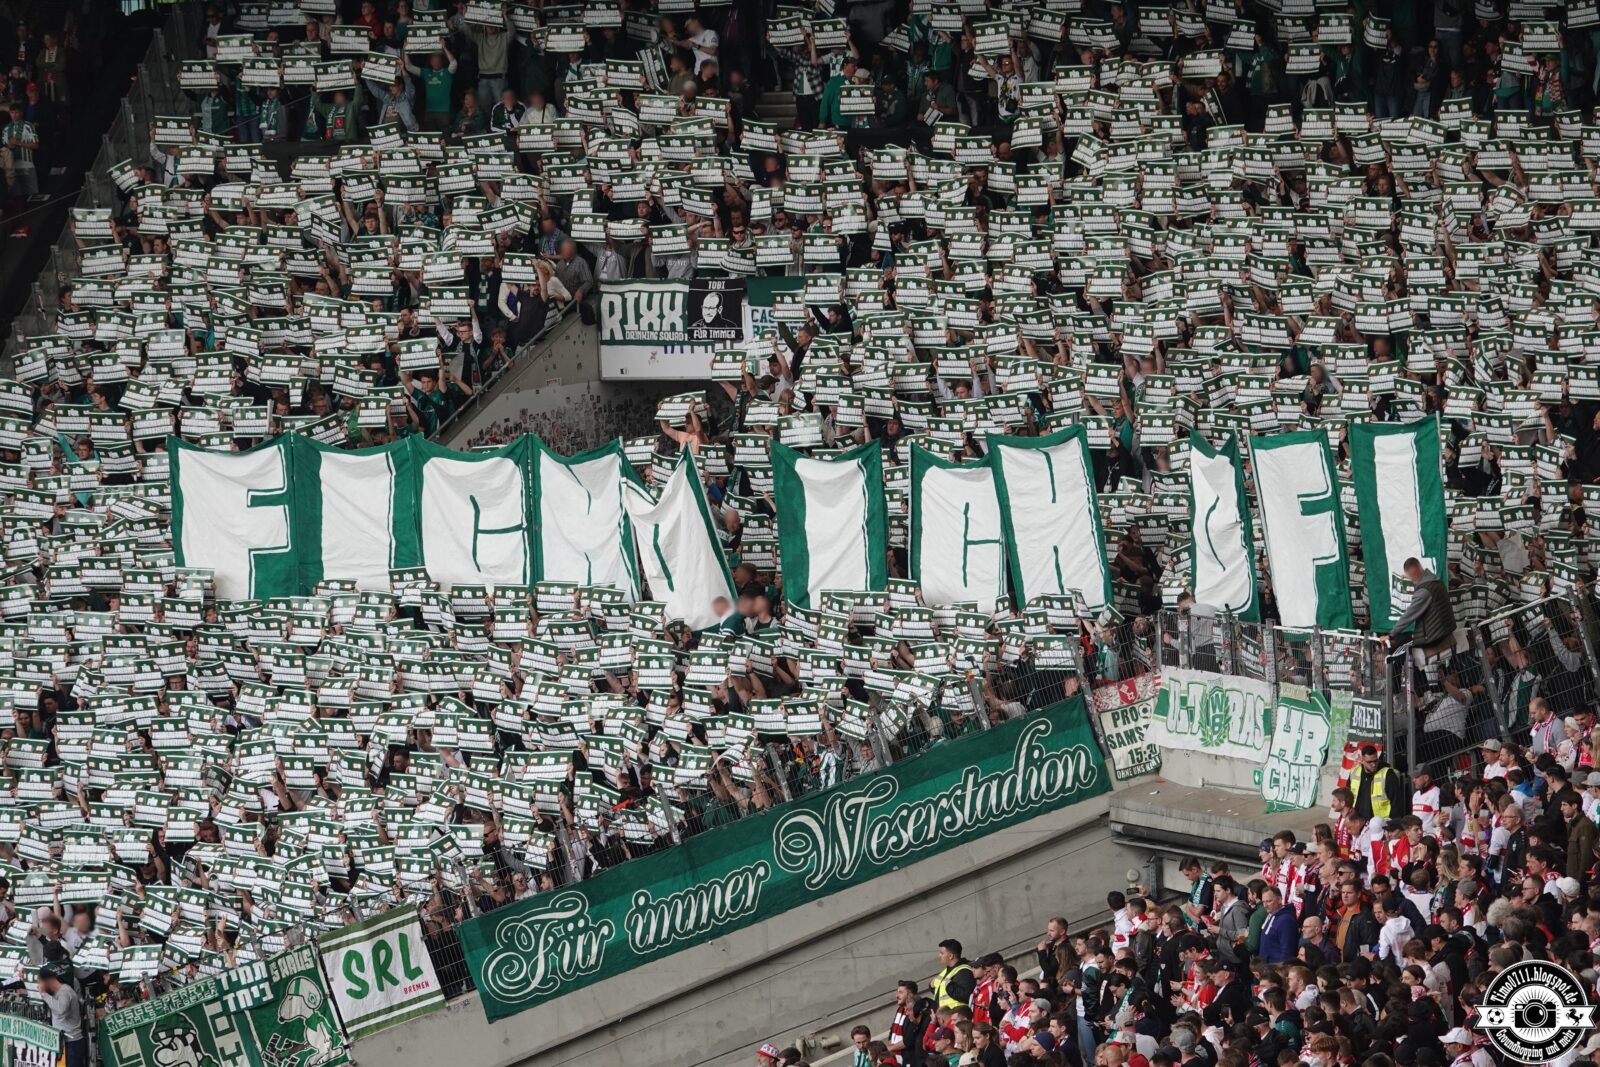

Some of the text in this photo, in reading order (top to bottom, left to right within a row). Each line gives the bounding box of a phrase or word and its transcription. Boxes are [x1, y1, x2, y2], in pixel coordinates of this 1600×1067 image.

[708, 281, 726, 290] TOBI
[601, 292, 683, 340] RIXX
[625, 330, 684, 341] DRINKING SQUAD
[709, 329, 736, 339] IMMER
[1111, 706, 1139, 728] PRO
[1271, 703, 1330, 765] HB
[1262, 760, 1319, 809] CREW
[482, 718, 1098, 1004] Für immer Weserstadion
[342, 932, 423, 999] SRL
[403, 981, 430, 995] BREMEN
[13, 1040, 56, 1064] TOBI
